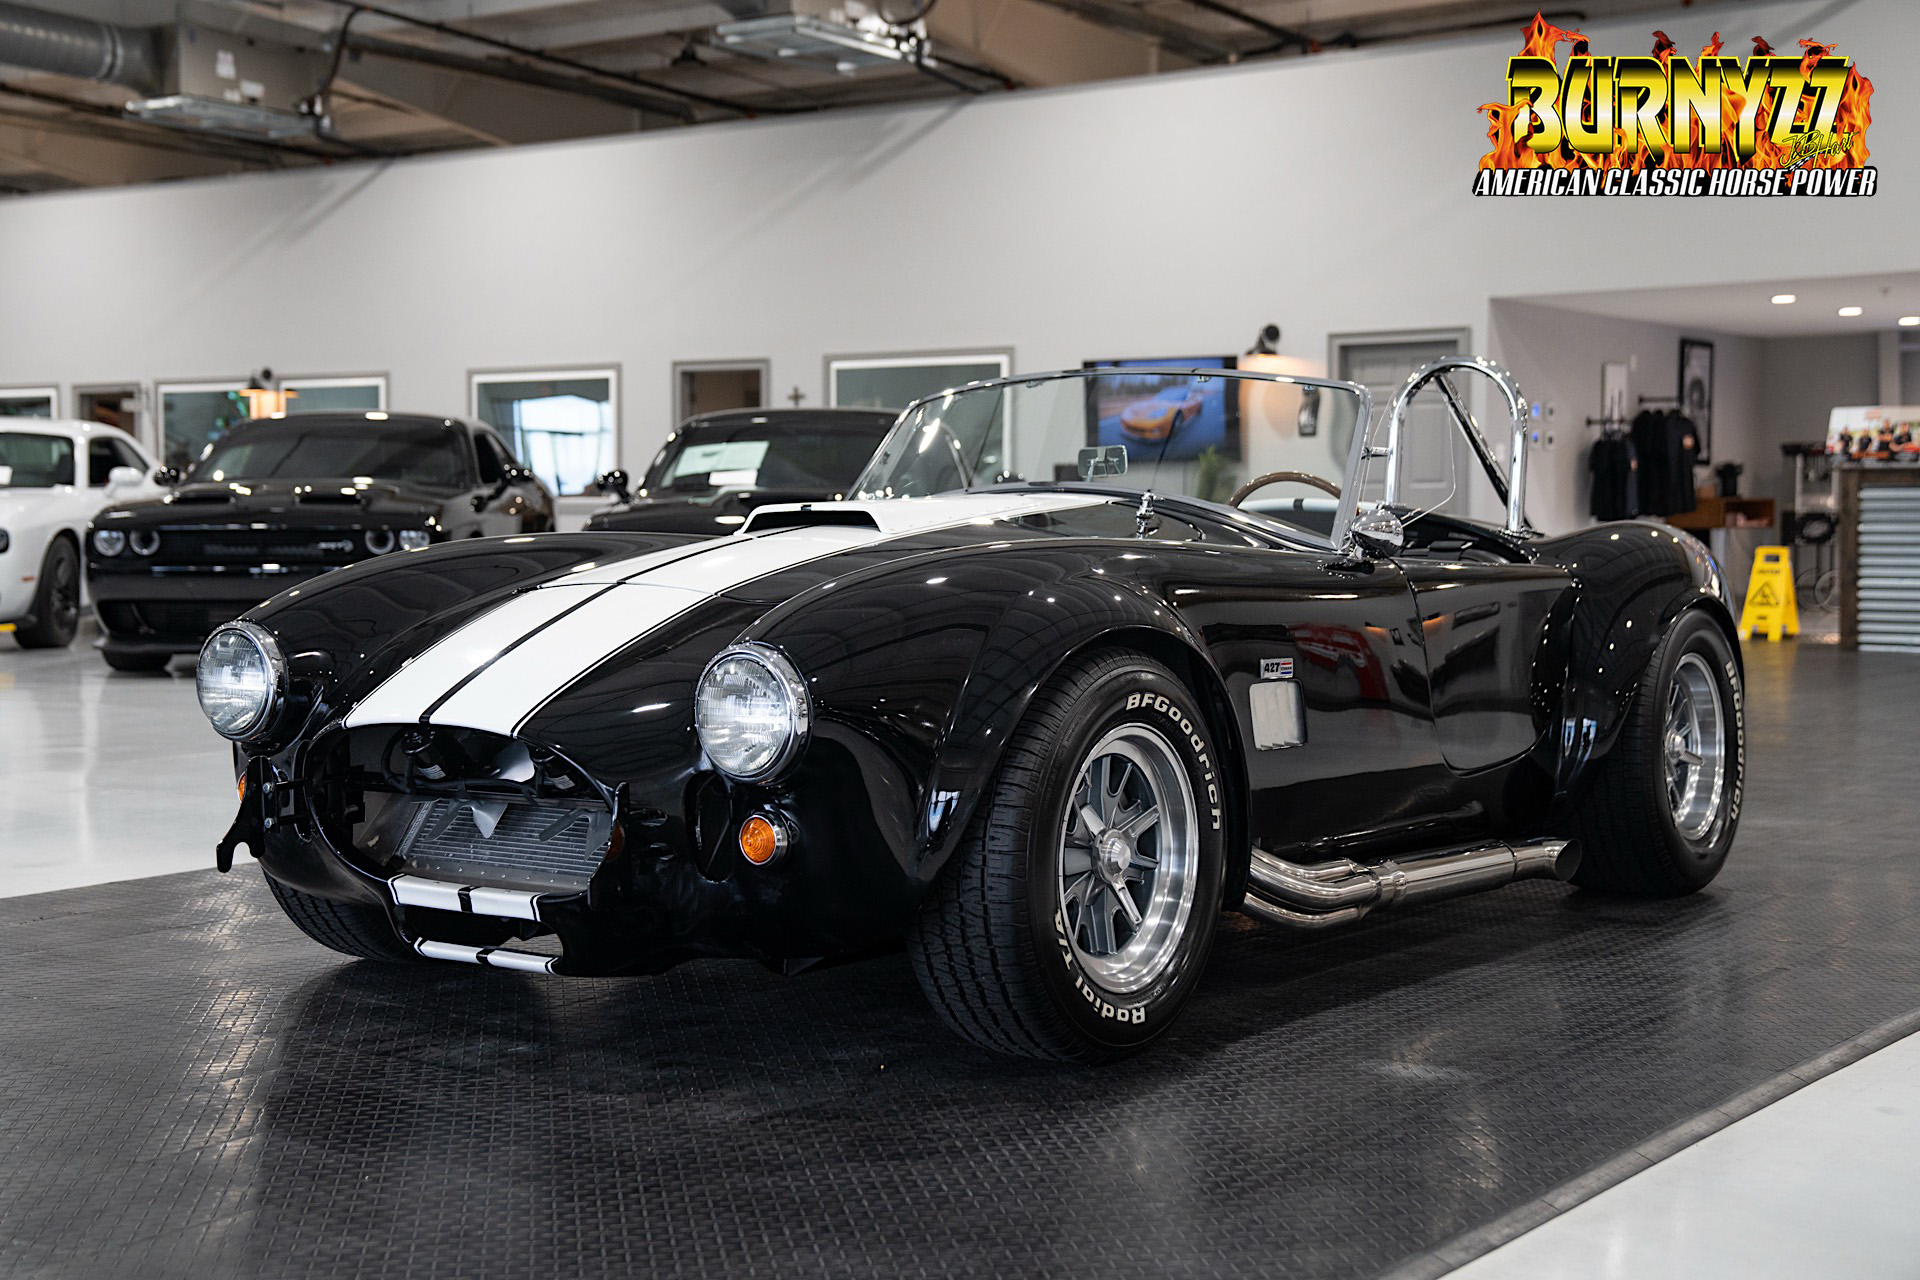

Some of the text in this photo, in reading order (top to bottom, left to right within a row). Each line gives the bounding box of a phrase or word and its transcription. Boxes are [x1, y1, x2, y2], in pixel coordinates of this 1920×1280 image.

[1264, 662, 1280, 673] 427
[1125, 692, 1221, 830] BFGoodrich
[1724, 660, 1745, 821] BFGoodrich
[1054, 908, 1146, 1024] Radial T/A
